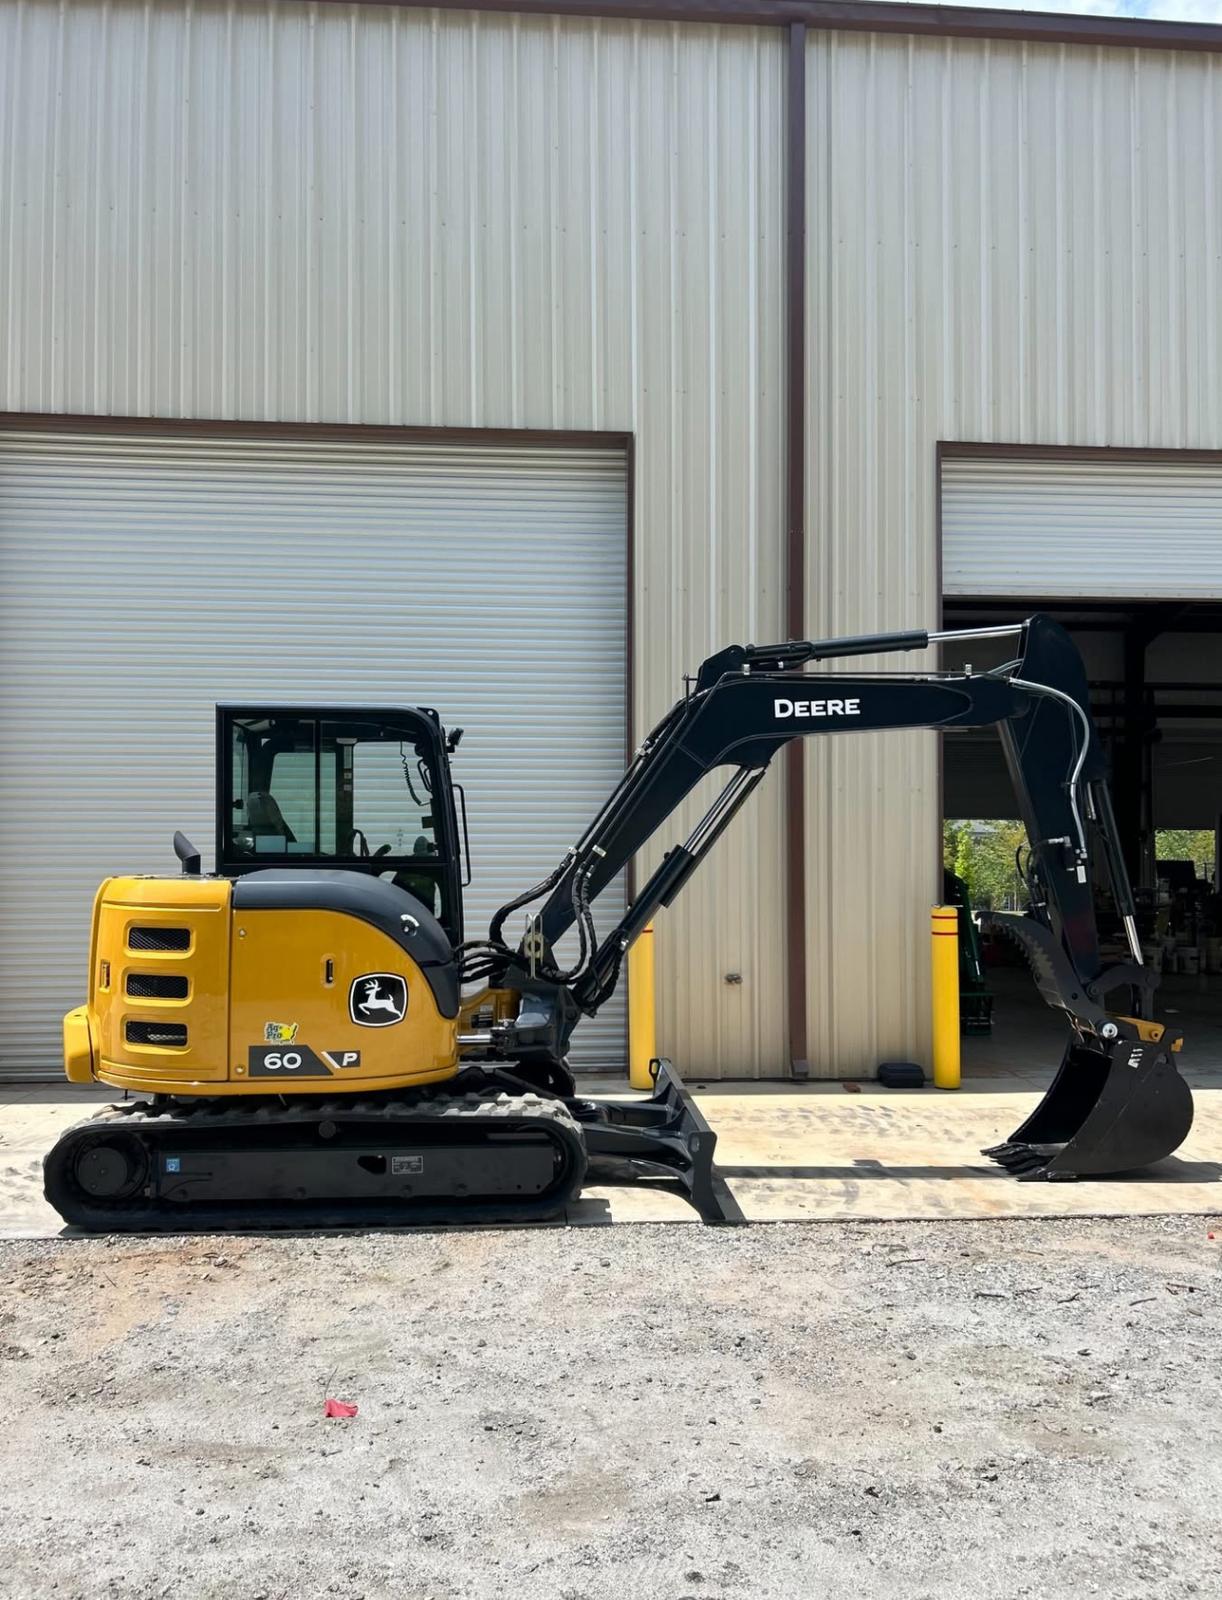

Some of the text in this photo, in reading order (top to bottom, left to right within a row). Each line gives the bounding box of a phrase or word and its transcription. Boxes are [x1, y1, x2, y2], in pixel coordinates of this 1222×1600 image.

[774, 698, 860, 718] DEERE
[263, 1052, 358, 1070] 60 P
